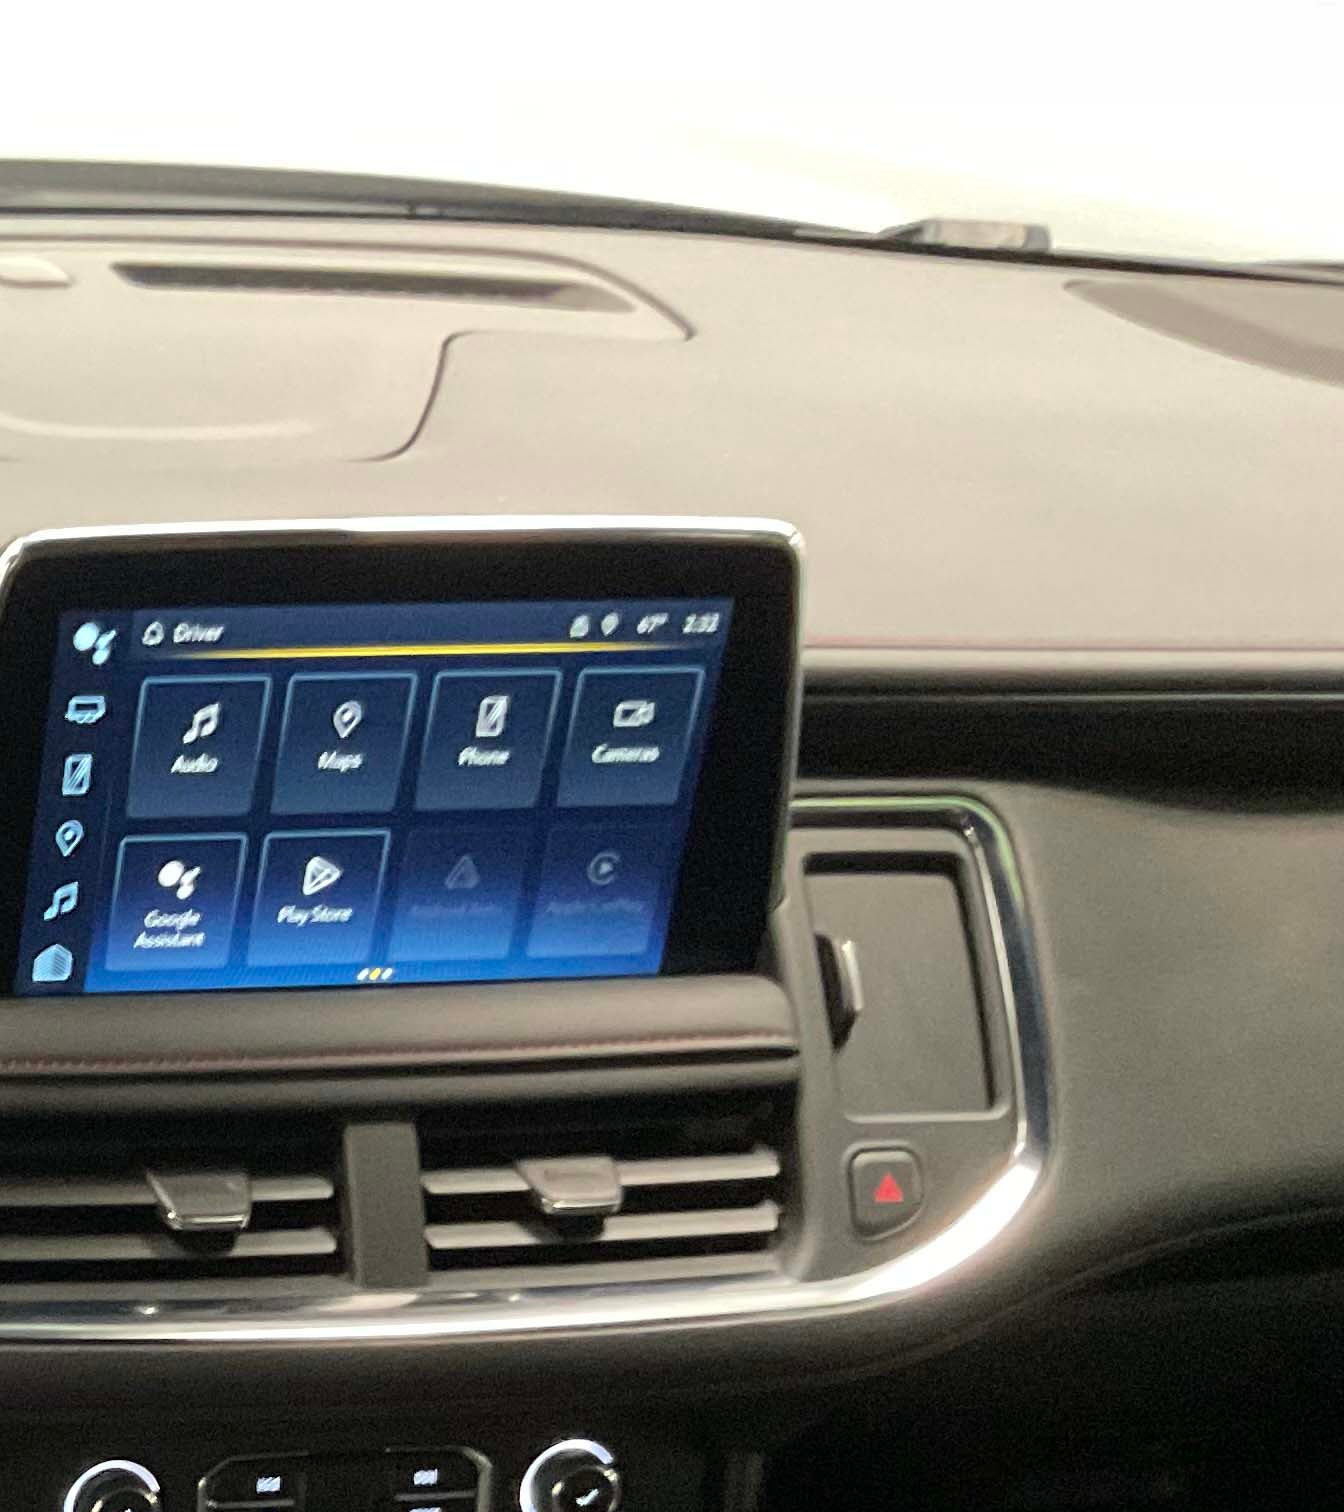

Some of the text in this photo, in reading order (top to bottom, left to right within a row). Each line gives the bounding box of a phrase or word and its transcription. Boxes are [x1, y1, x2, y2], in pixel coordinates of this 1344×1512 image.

[173, 622, 225, 644] Driver
[170, 752, 220, 774] Audio
[317, 751, 364, 773] Maps
[457, 746, 510, 767] Phone
[591, 743, 660, 764] Cameras
[144, 909, 202, 932] Google
[277, 904, 353, 927] Play Store
[133, 930, 205, 949] Assistant
